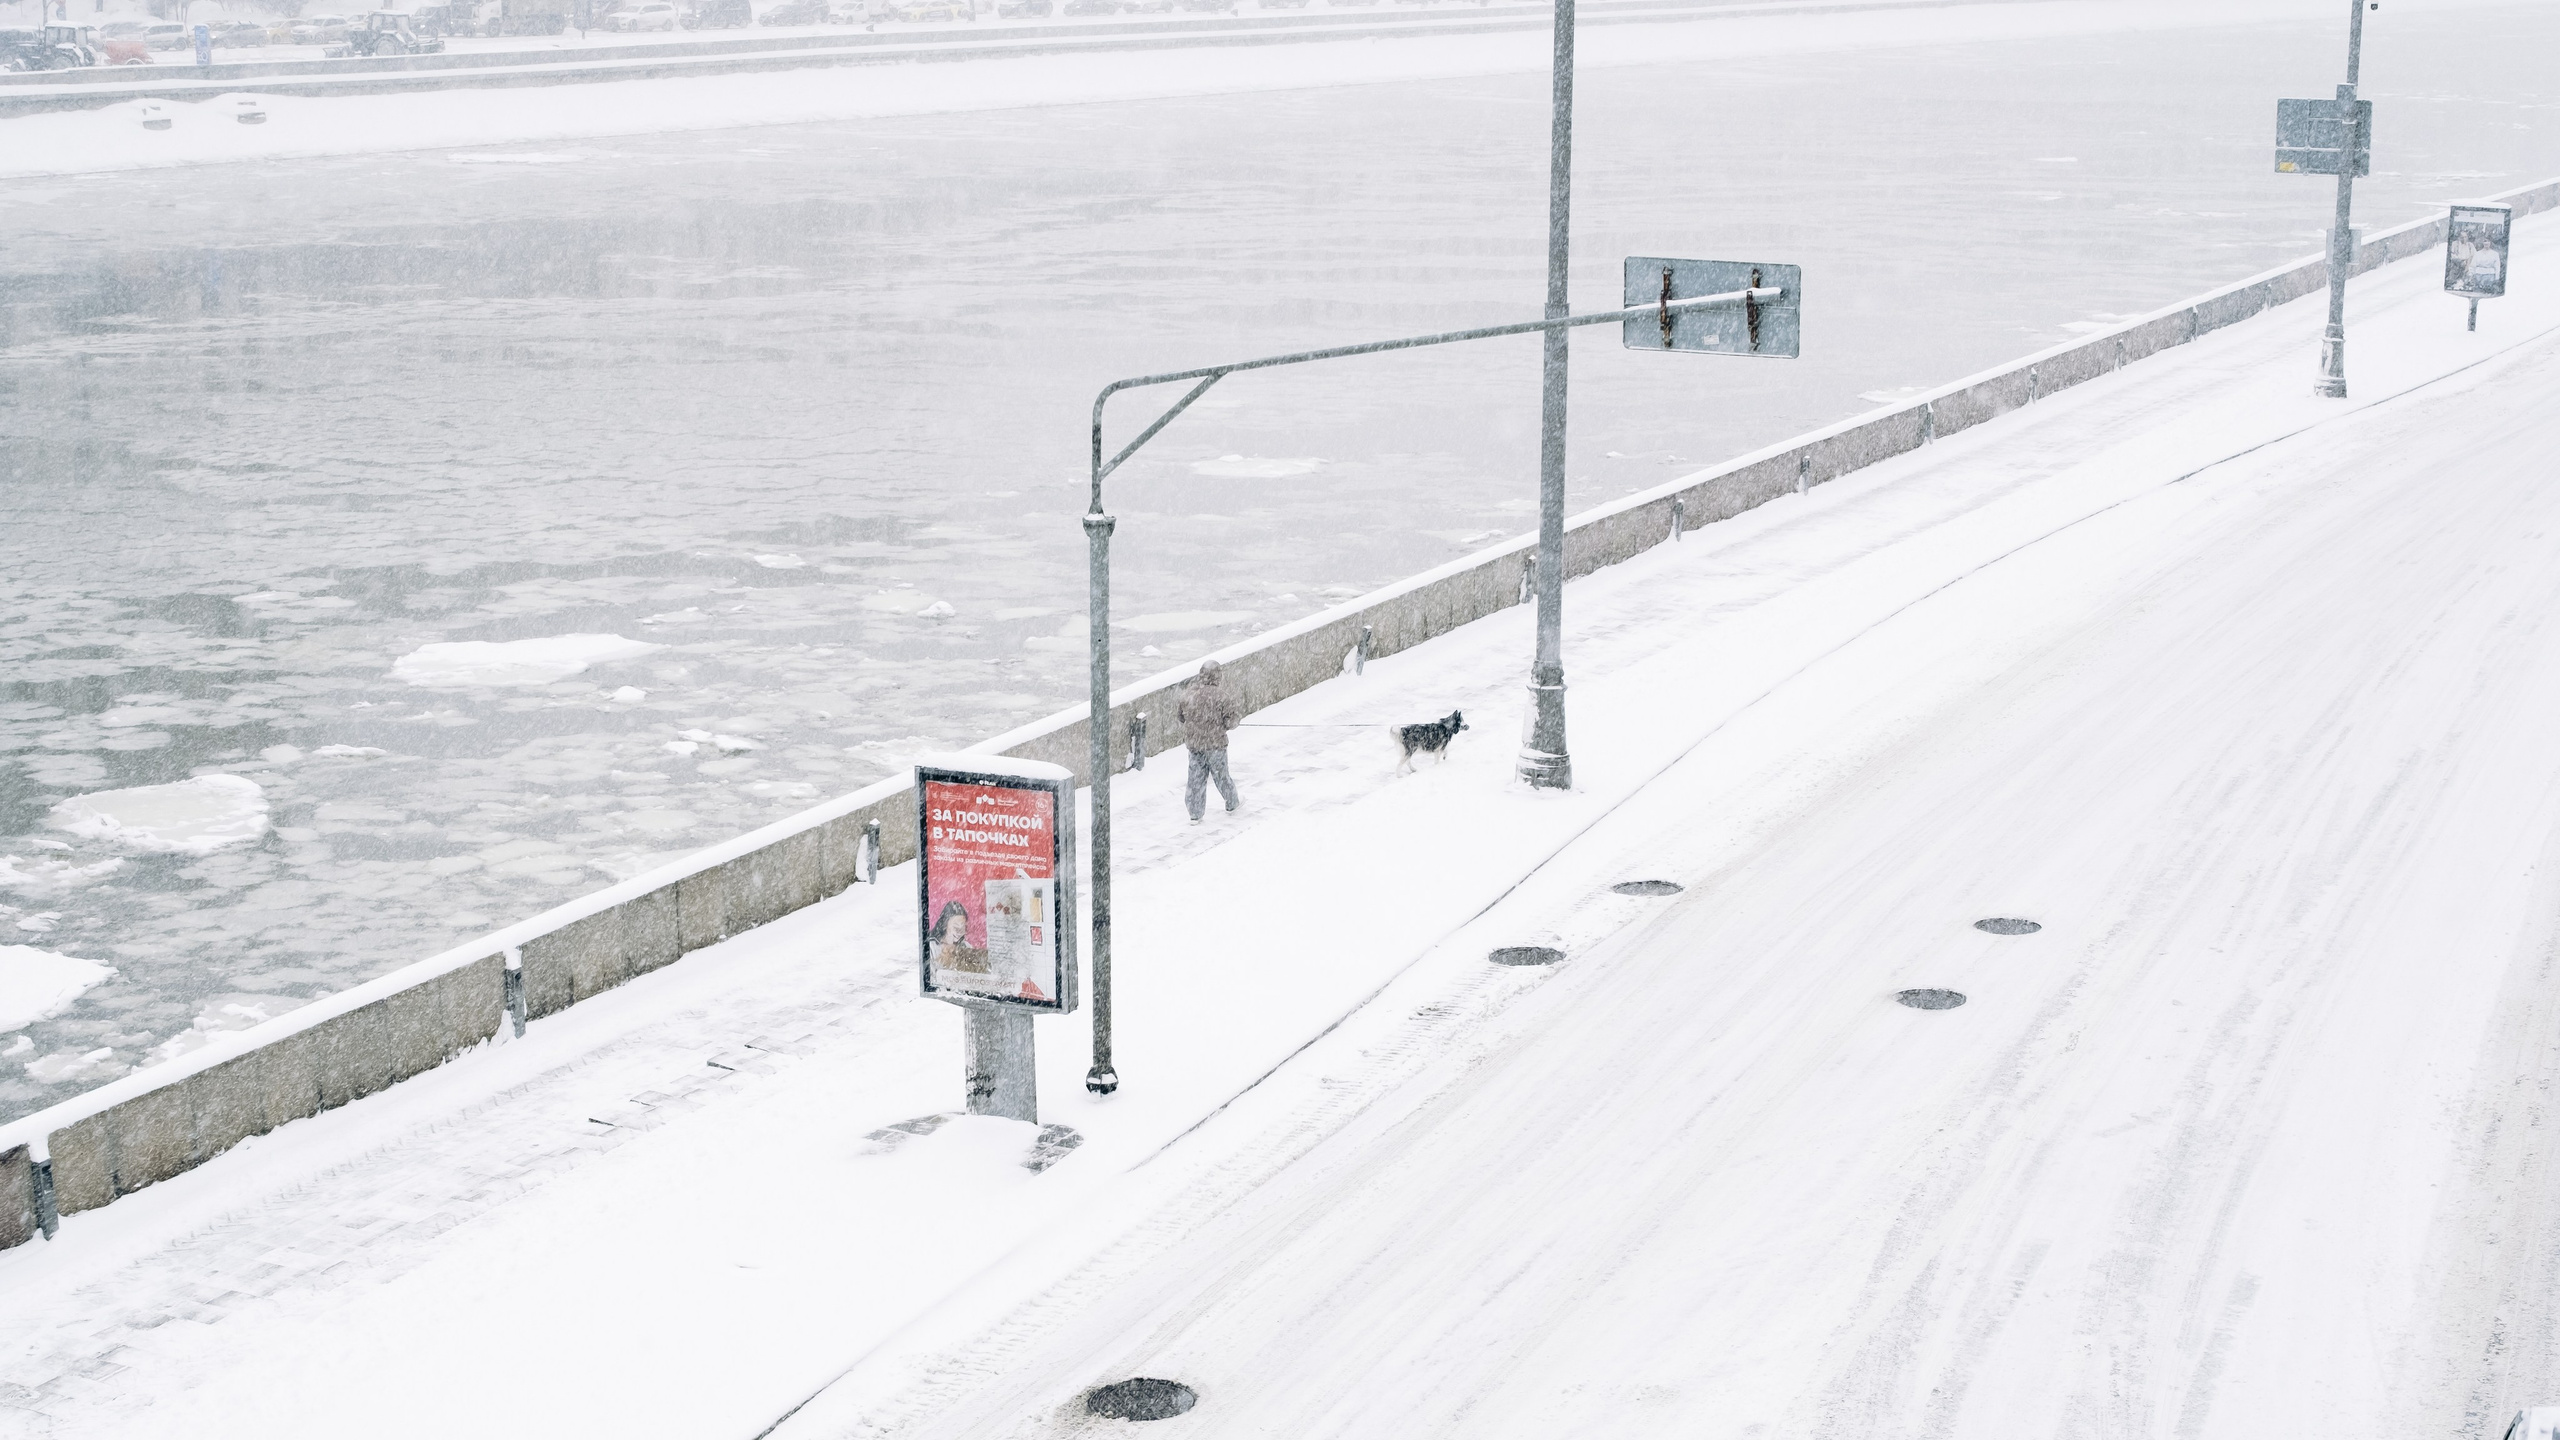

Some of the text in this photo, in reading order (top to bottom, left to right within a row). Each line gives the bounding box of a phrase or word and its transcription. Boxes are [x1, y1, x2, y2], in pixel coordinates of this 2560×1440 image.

[933, 809, 1042, 829] ЗА ПОКУПКОЙ
[933, 826, 1029, 847] В ТАПОЧКАХ
[933, 845, 969, 855] Забирайте
[1006, 853, 1030, 861] своего
